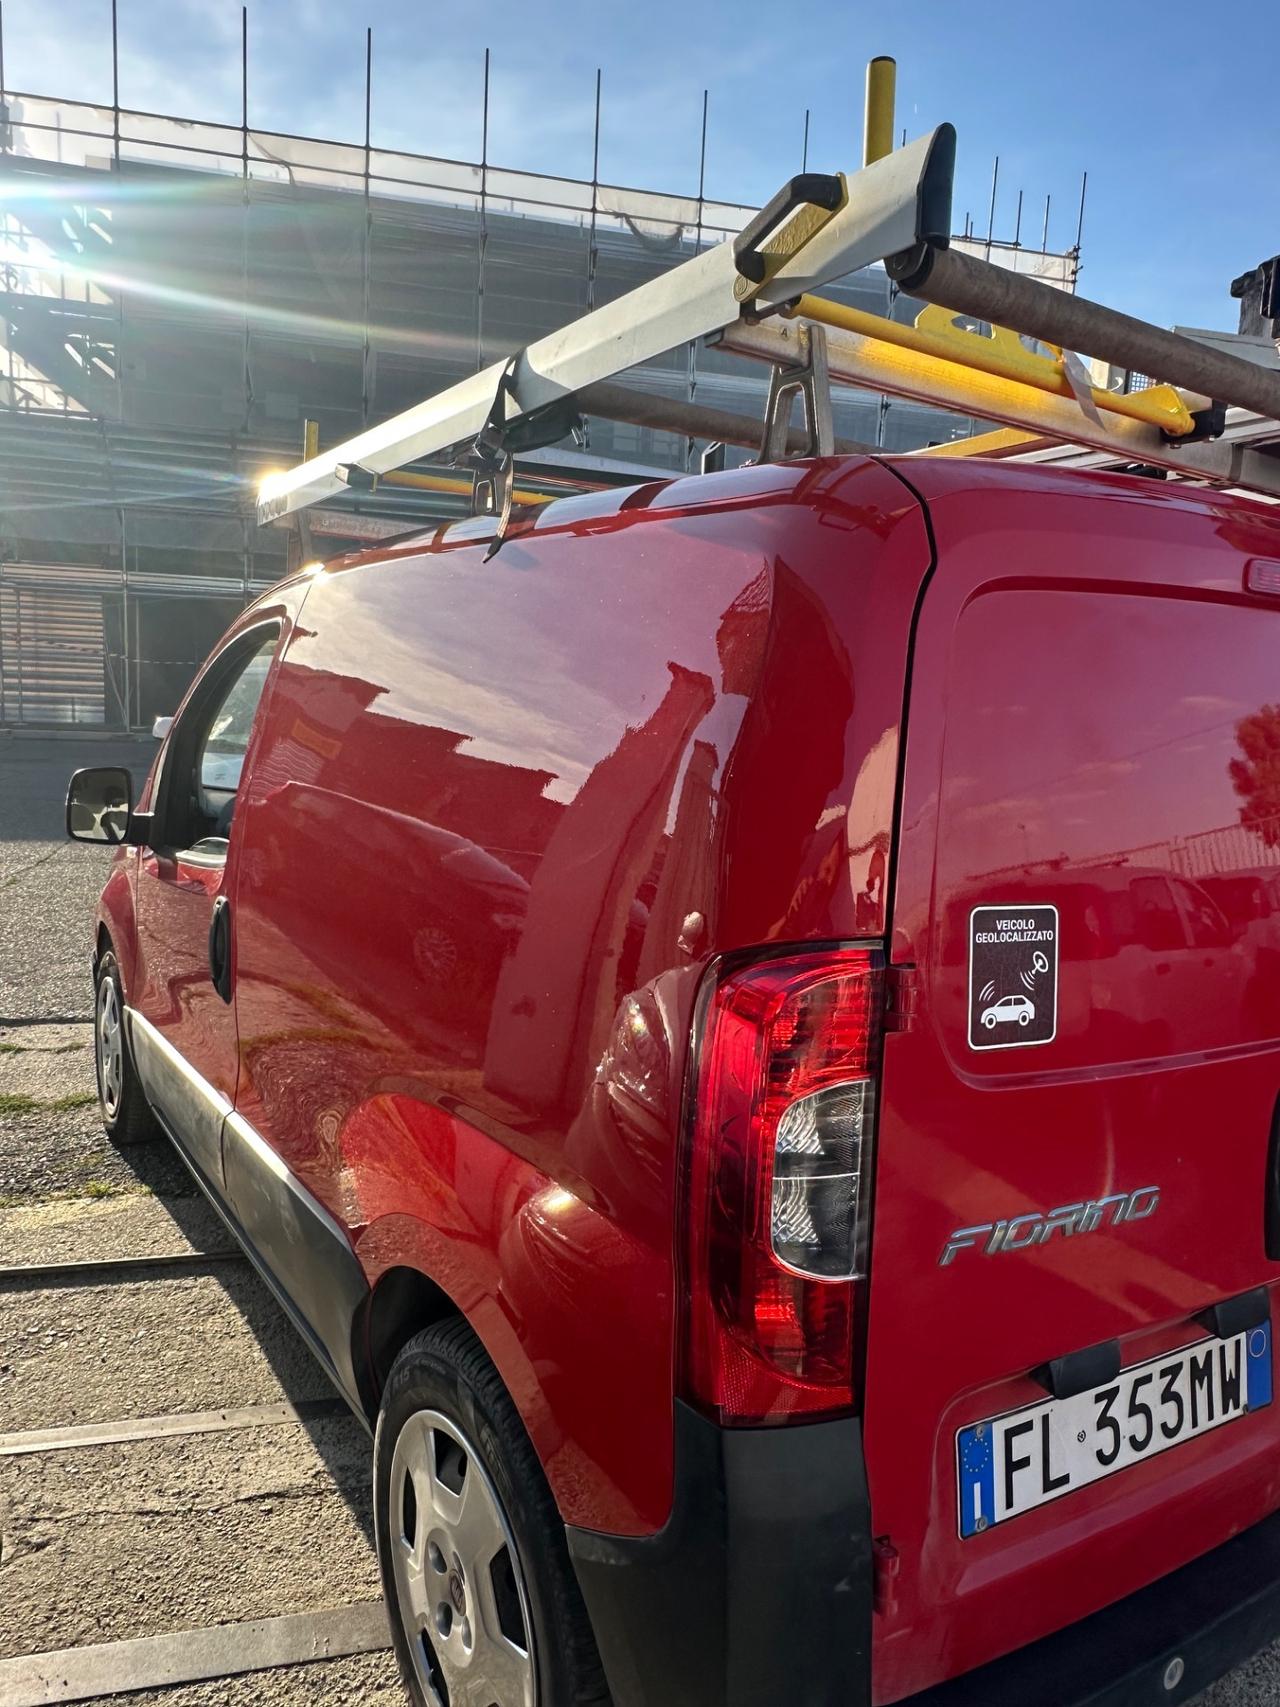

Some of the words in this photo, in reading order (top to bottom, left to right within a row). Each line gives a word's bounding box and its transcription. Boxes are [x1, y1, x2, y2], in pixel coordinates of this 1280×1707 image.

[975, 930, 1054, 943] GEOLOCALIZZATO
[996, 919, 1035, 930] VEICOLO
[1003, 1411, 1070, 1511] FL
[1093, 1338, 1242, 1467] 353MW
[973, 1482, 982, 1520] I
